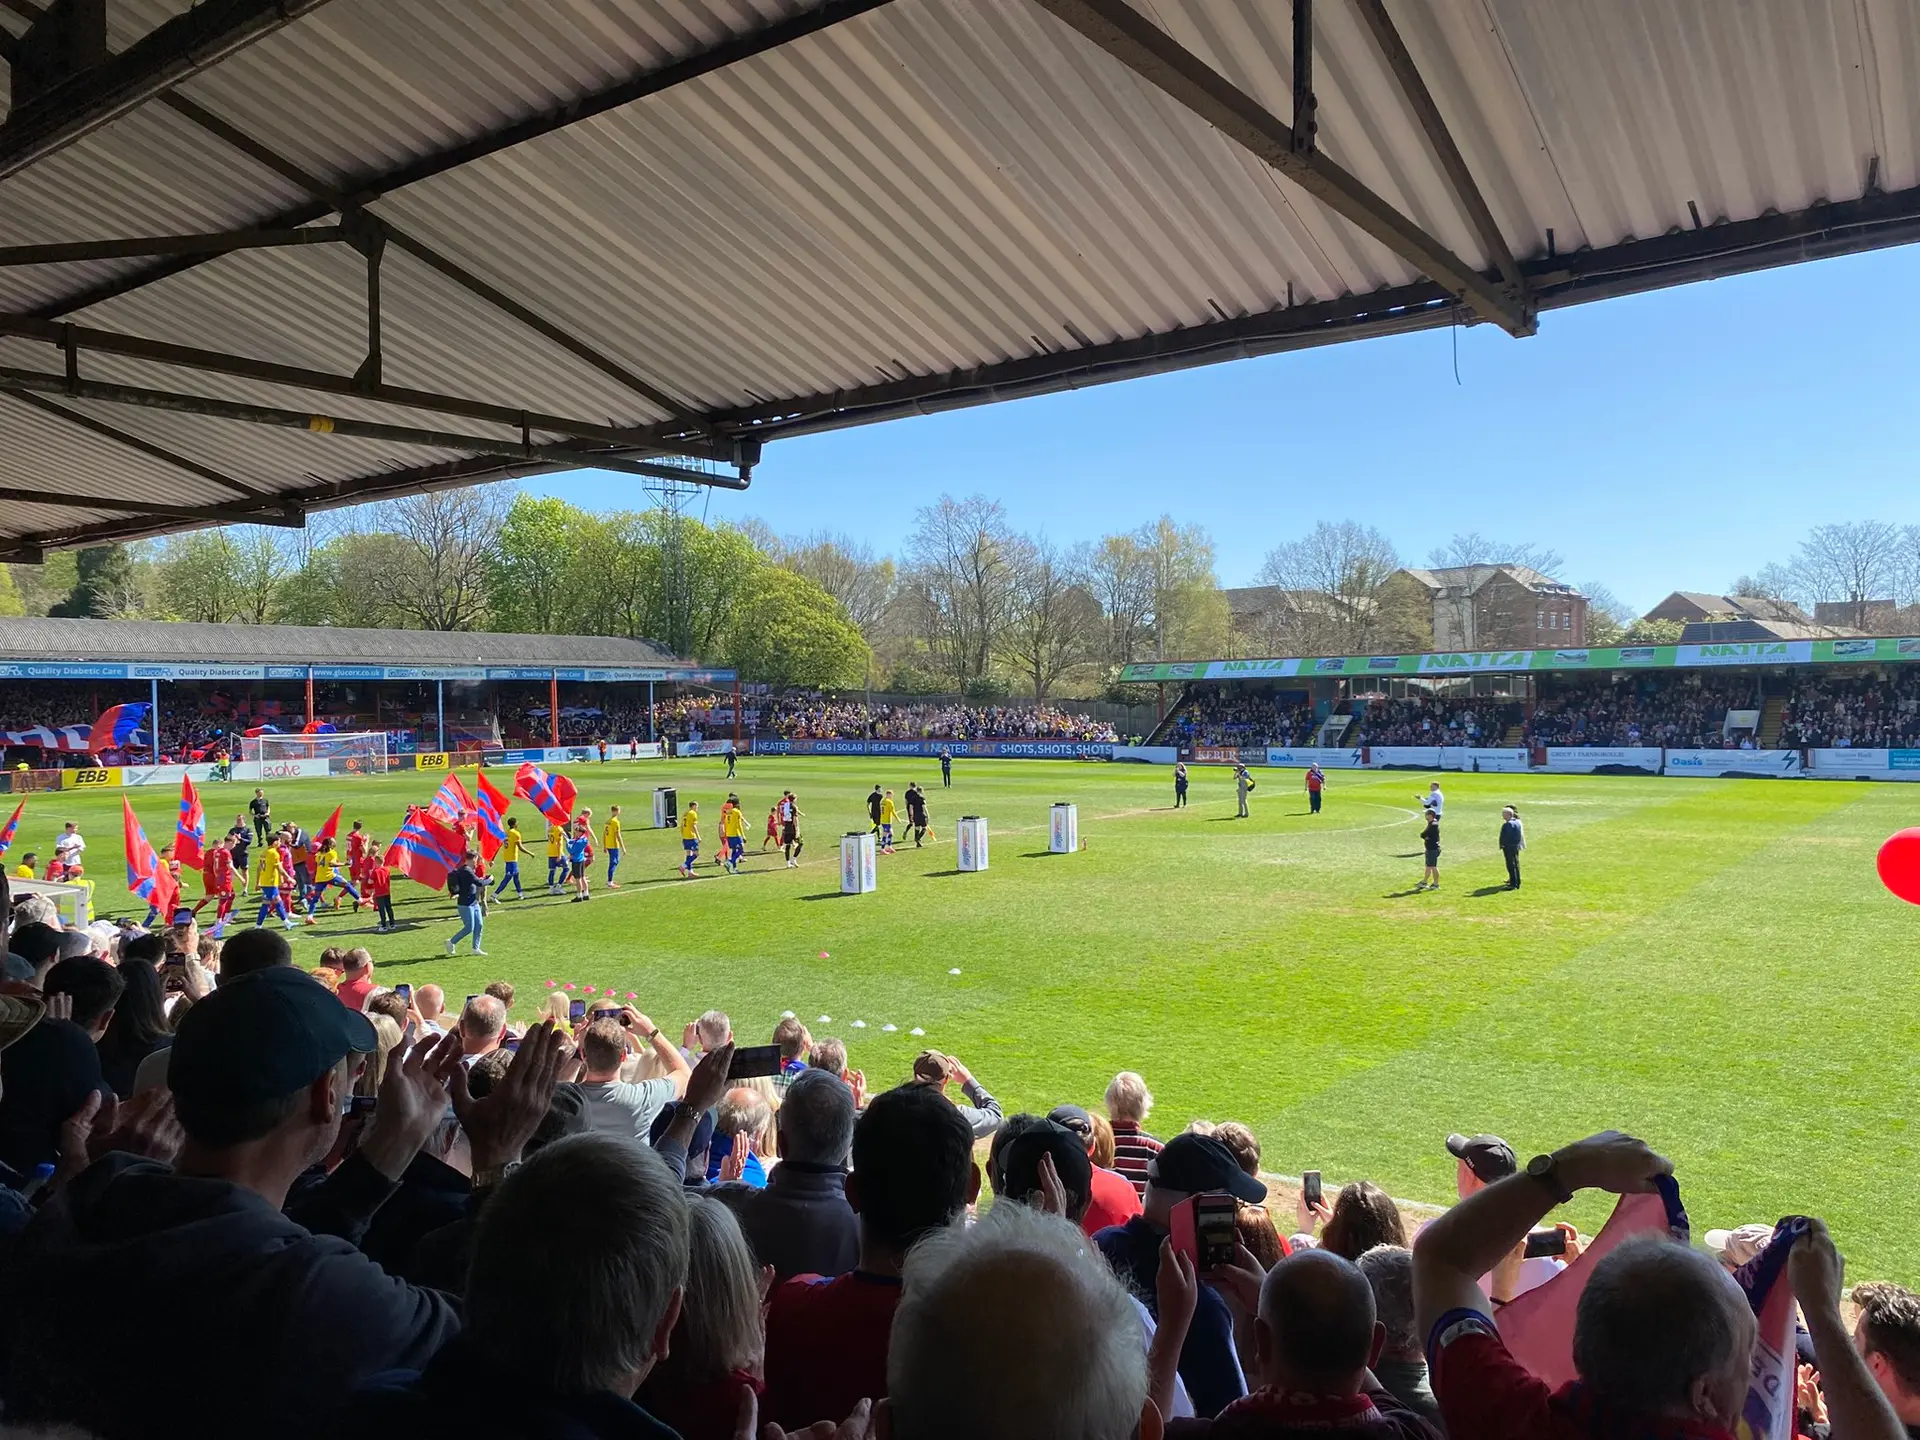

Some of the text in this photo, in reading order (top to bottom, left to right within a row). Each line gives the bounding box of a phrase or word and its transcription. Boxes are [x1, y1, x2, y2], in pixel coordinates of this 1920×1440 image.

[1700, 643, 1787, 656] NATTA
[1426, 652, 1524, 668] NATTA
[28, 667, 61, 677] Quality
[63, 666, 97, 675] Diabetic
[102, 666, 122, 675] Care
[1222, 660, 1284, 672] NATTA
[179, 668, 207, 677] Quality
[210, 667, 240, 676] Diabetic
[243, 667, 259, 676] Care
[816, 741, 831, 751] GAS
[837, 741, 862, 751] SOLAR
[421, 754, 443, 765] EBB
[1271, 753, 1294, 762] Oasis
[1672, 757, 1703, 766] Oasis
[263, 761, 300, 777] evolve
[75, 770, 109, 784] EBB
